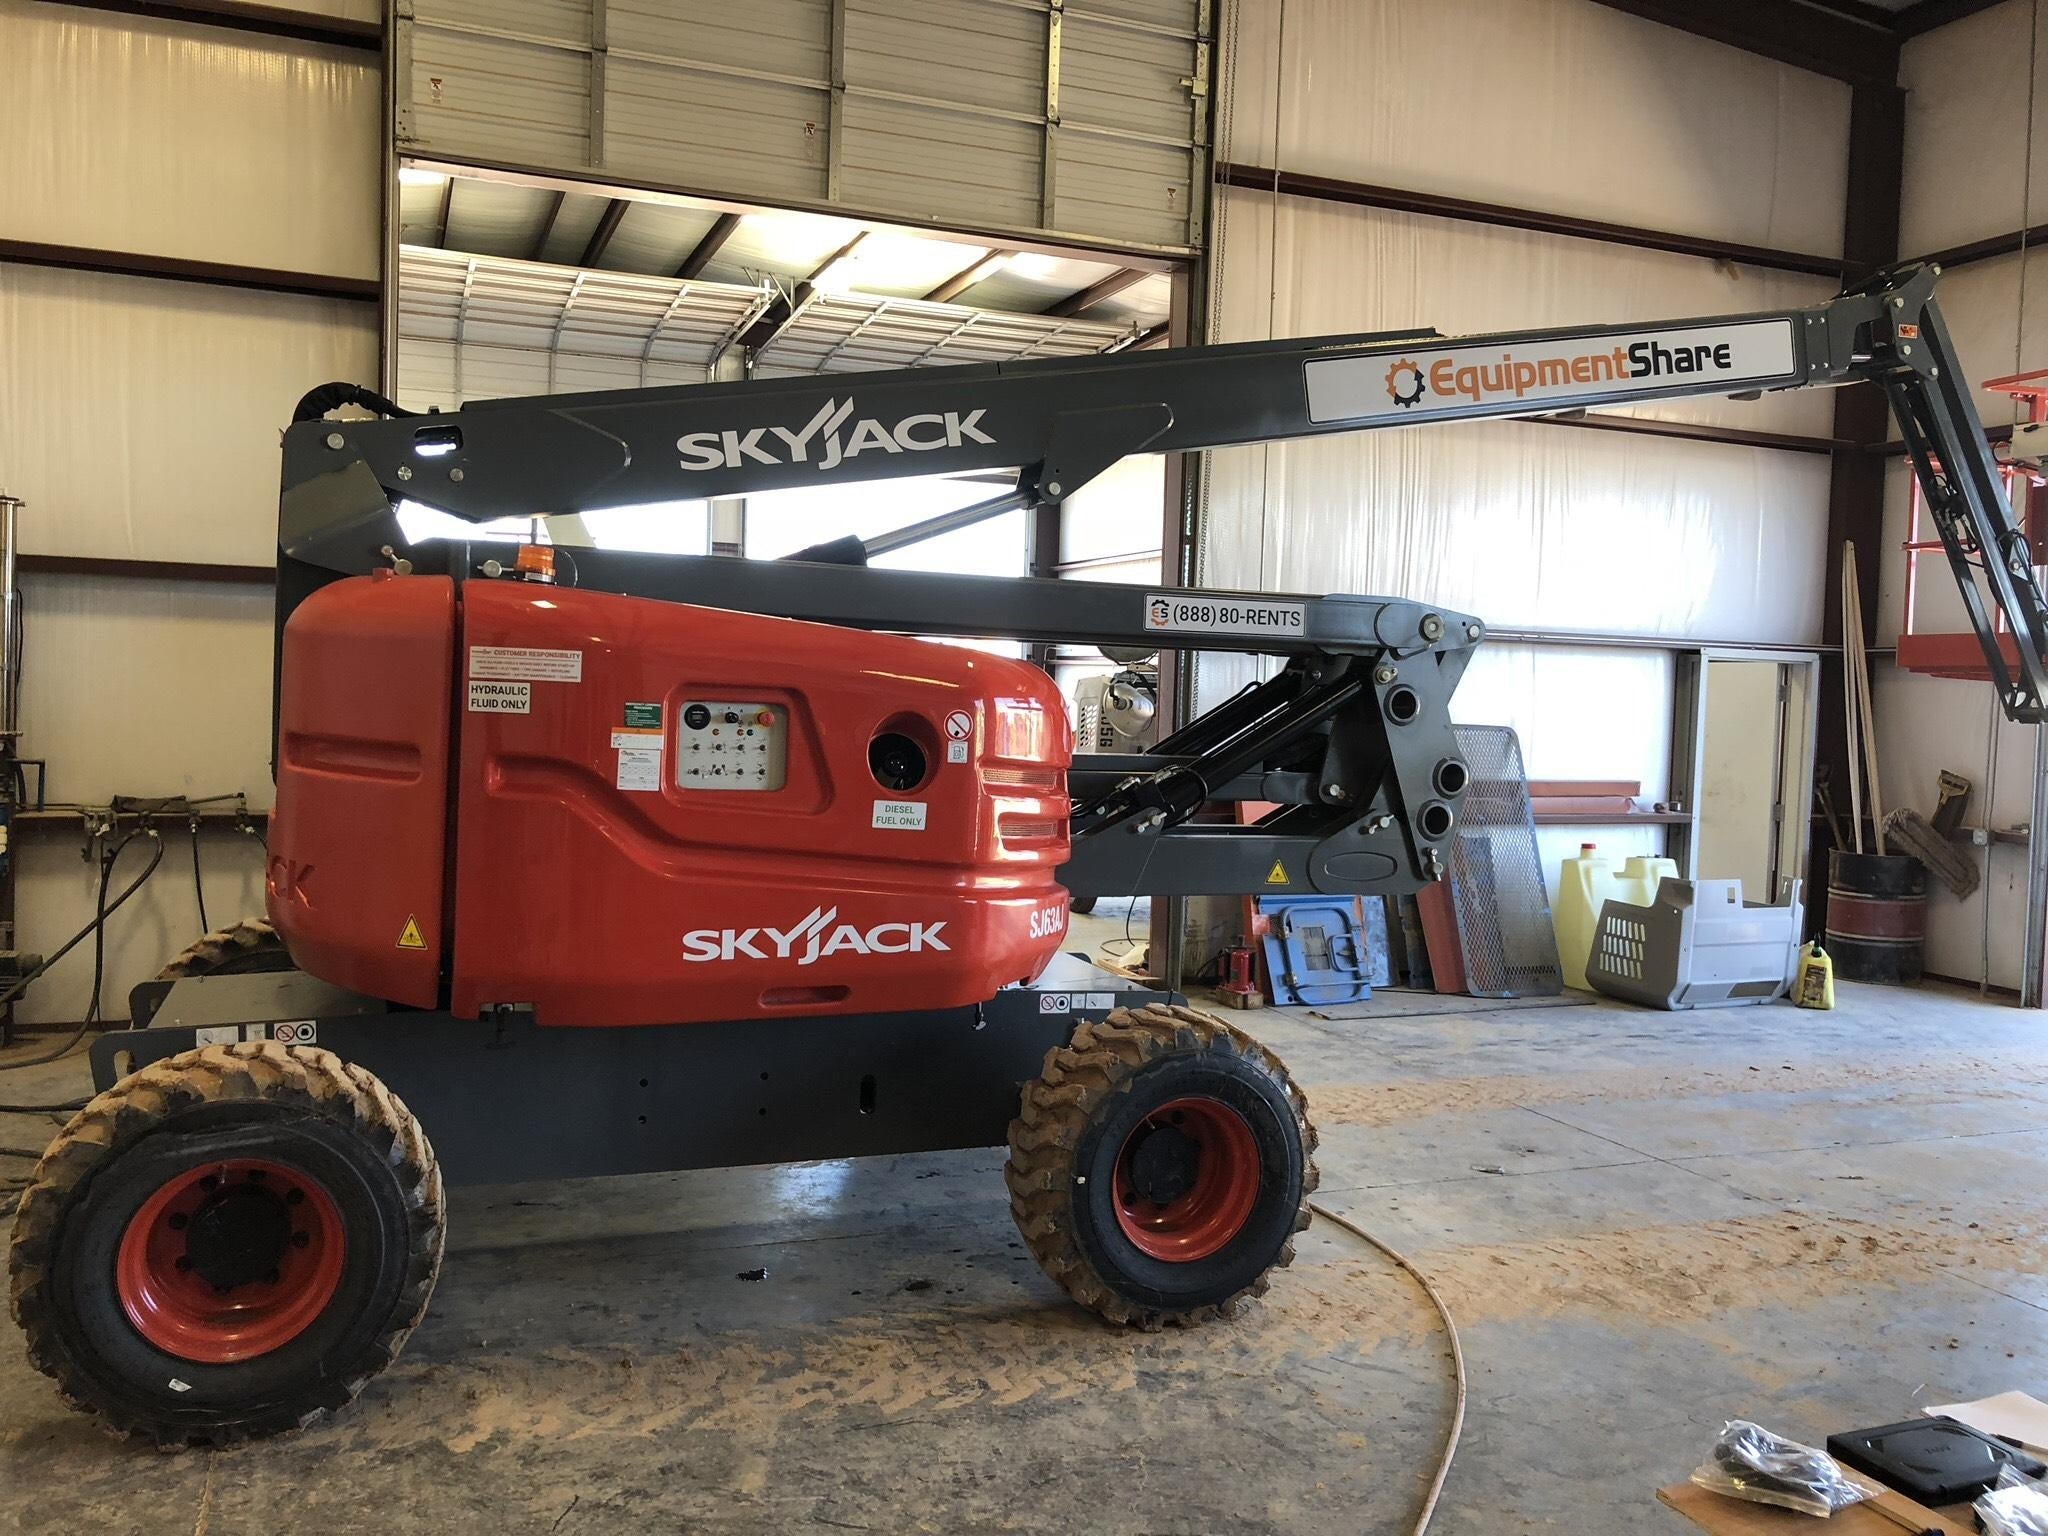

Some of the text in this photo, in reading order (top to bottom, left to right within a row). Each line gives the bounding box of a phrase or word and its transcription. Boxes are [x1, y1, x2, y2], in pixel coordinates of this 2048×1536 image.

[1430, 341, 1732, 401] EquipmentShare
[676, 396, 998, 470] SKYJACK
[493, 649, 528, 657] CUSTOMER
[528, 650, 581, 659] RESPONSIBILITY
[471, 684, 528, 696] HYDRAULIC
[471, 698, 528, 710] FLUID ONLY
[885, 804, 915, 814] DIESEL
[876, 815, 922, 826] FUEL ONLY
[1029, 903, 1065, 939] SJ63AJ
[682, 905, 951, 965] SKYJACK
